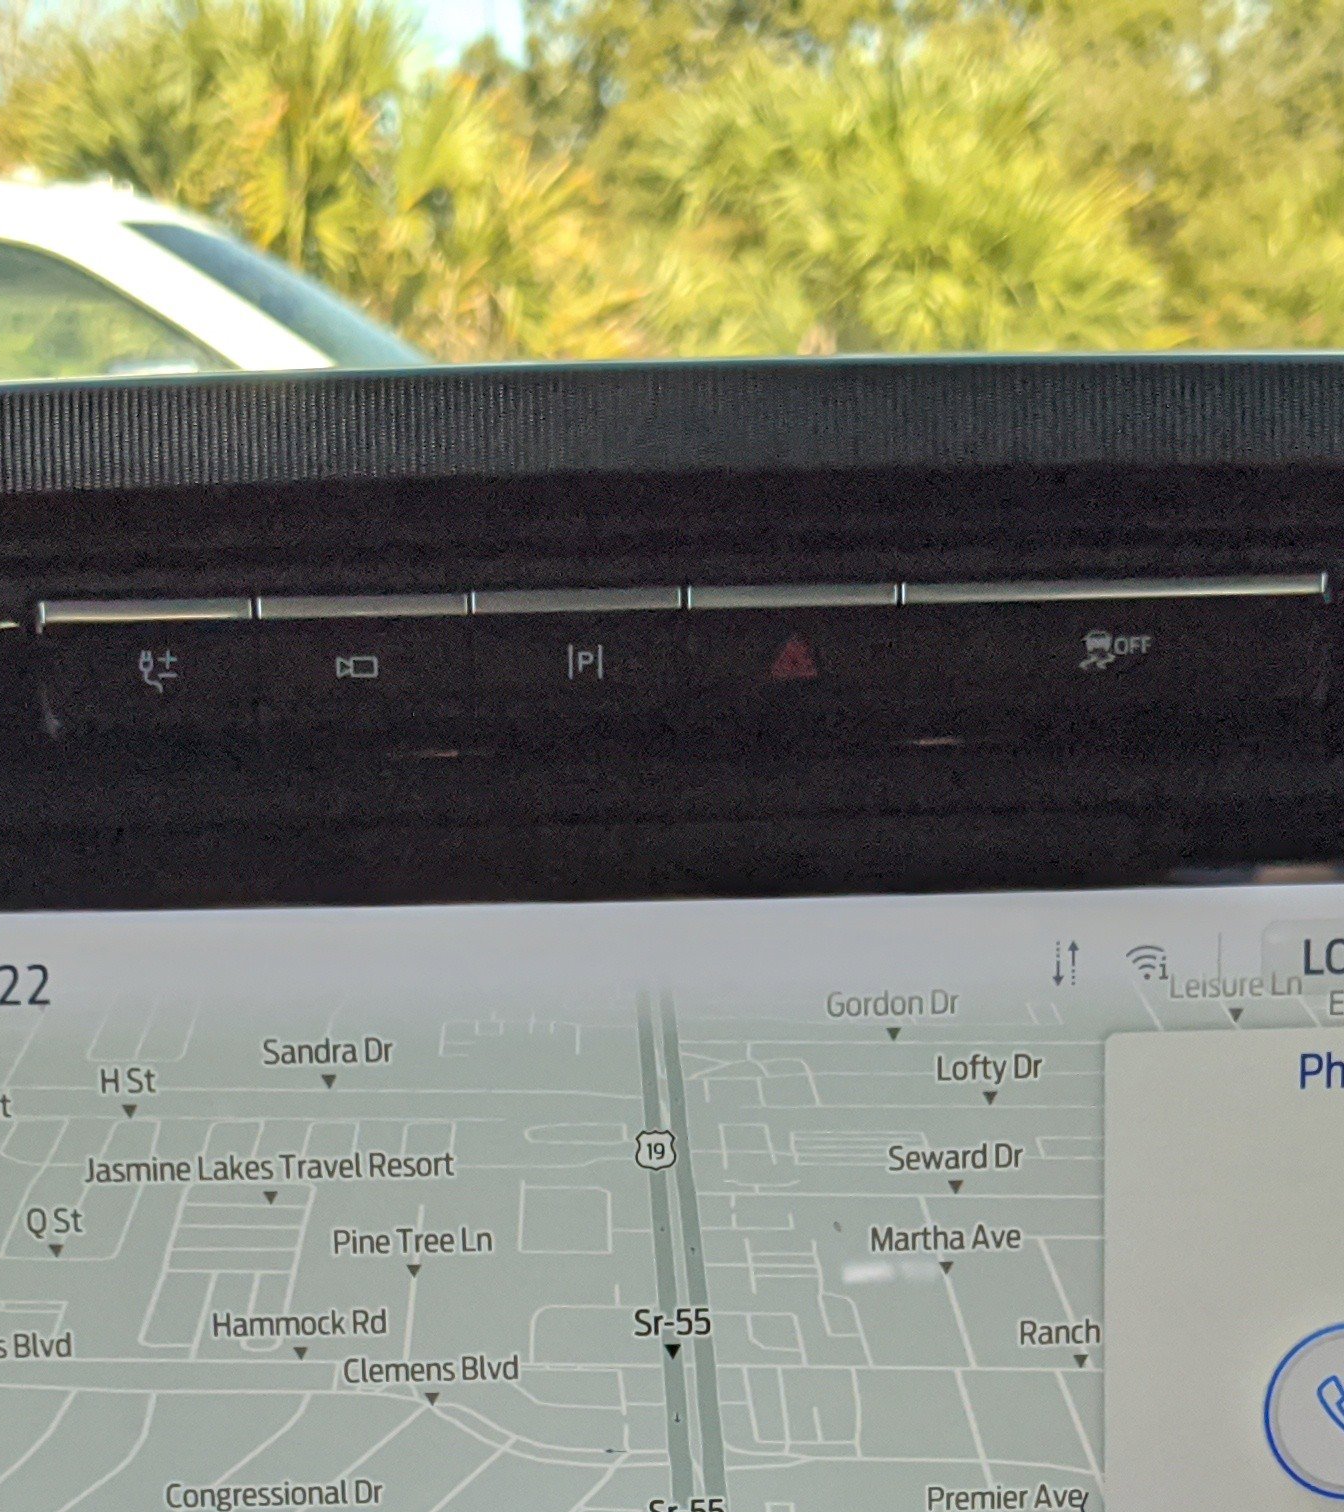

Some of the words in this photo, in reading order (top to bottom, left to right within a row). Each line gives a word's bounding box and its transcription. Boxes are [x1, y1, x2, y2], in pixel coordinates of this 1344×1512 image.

[1114, 635, 1152, 656] OFF
[1169, 974, 1264, 999] Leisure
[1270, 971, 1303, 996] Ln
[827, 991, 923, 1018] Gordon
[930, 989, 959, 1015] Dr
[262, 1038, 357, 1066] Sandra
[364, 1037, 393, 1063] Dr
[100, 1069, 122, 1093] H
[126, 1067, 156, 1093] St
[937, 1055, 1006, 1085] Lofty
[1014, 1053, 1042, 1078] Dr
[647, 1143, 666, 1162] 19
[888, 1145, 987, 1172] Seward
[994, 1144, 1024, 1169] Dr
[85, 1156, 192, 1184] Jasmine
[197, 1155, 274, 1181] Lakes
[279, 1153, 361, 1179] Travel
[369, 1152, 455, 1178] Resort
[26, 1209, 48, 1240] Q
[52, 1207, 84, 1233] St
[335, 1229, 390, 1255] Pine
[396, 1228, 455, 1253] Tree
[462, 1227, 493, 1252] Ln
[871, 1226, 965, 1253] Martha
[972, 1224, 1022, 1250] Ave
[213, 1308, 345, 1337] Hammock
[353, 1308, 388, 1335] Rd
[634, 1309, 712, 1337] Sr-55
[1020, 1319, 1101, 1345] Ranch
[14, 1332, 72, 1358] Blvd
[344, 1357, 456, 1384] Clemens
[462, 1355, 520, 1381] Blvd
[166, 1480, 347, 1512] Congressional
[354, 1480, 383, 1505] Dr
[927, 1485, 1028, 1512] Premier
[1034, 1483, 1083, 1509] Ave
